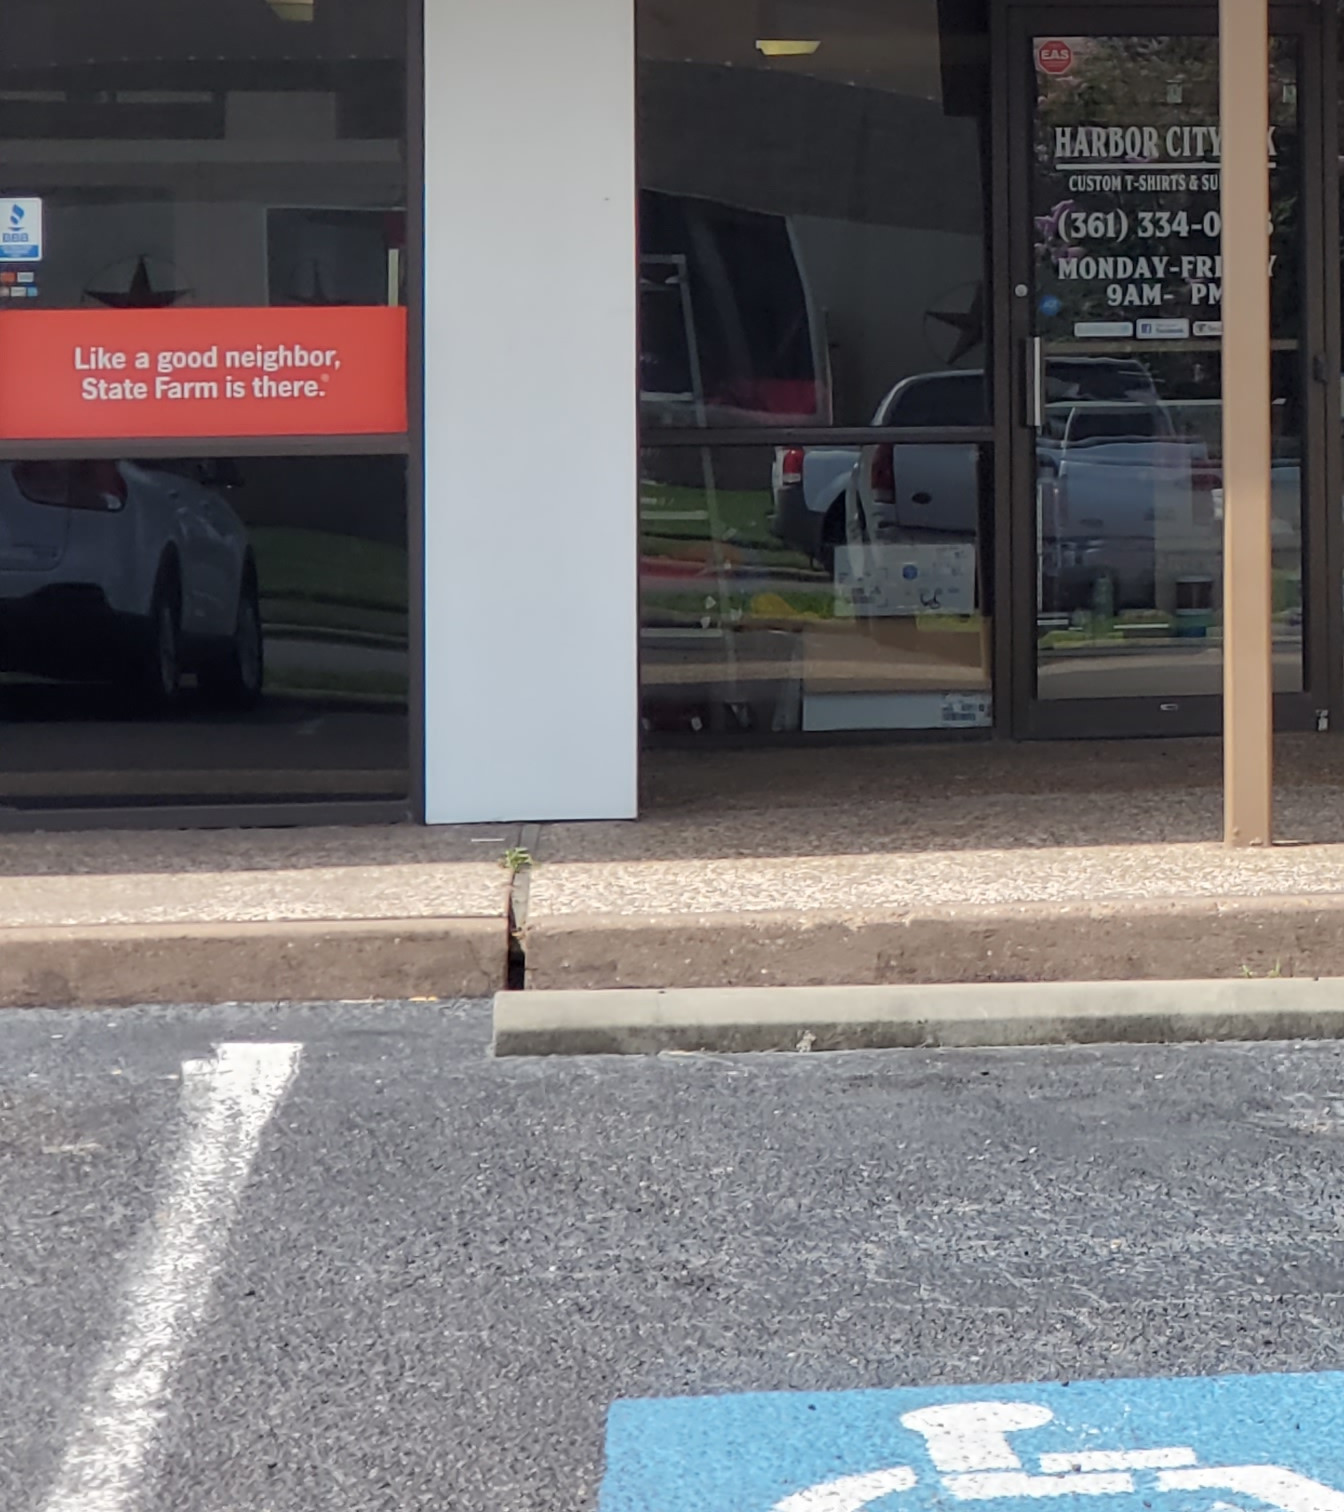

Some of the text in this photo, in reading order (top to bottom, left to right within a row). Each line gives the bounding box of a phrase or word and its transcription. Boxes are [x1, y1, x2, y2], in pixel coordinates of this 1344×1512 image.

[1040, 49, 1070, 61] EAS
[1054, 126, 1222, 158] HARBOR CITY
[1068, 175, 1122, 191] CUSTOM
[1125, 175, 1187, 191] T-SHIRTS
[1188, 175, 1200, 191] &
[1057, 208, 1274, 242] (361) 334-0
[1058, 255, 1277, 279] MONDAY-FRI
[74, 345, 341, 373] Like a good neighbor,
[82, 376, 325, 400] State Farm is there.
